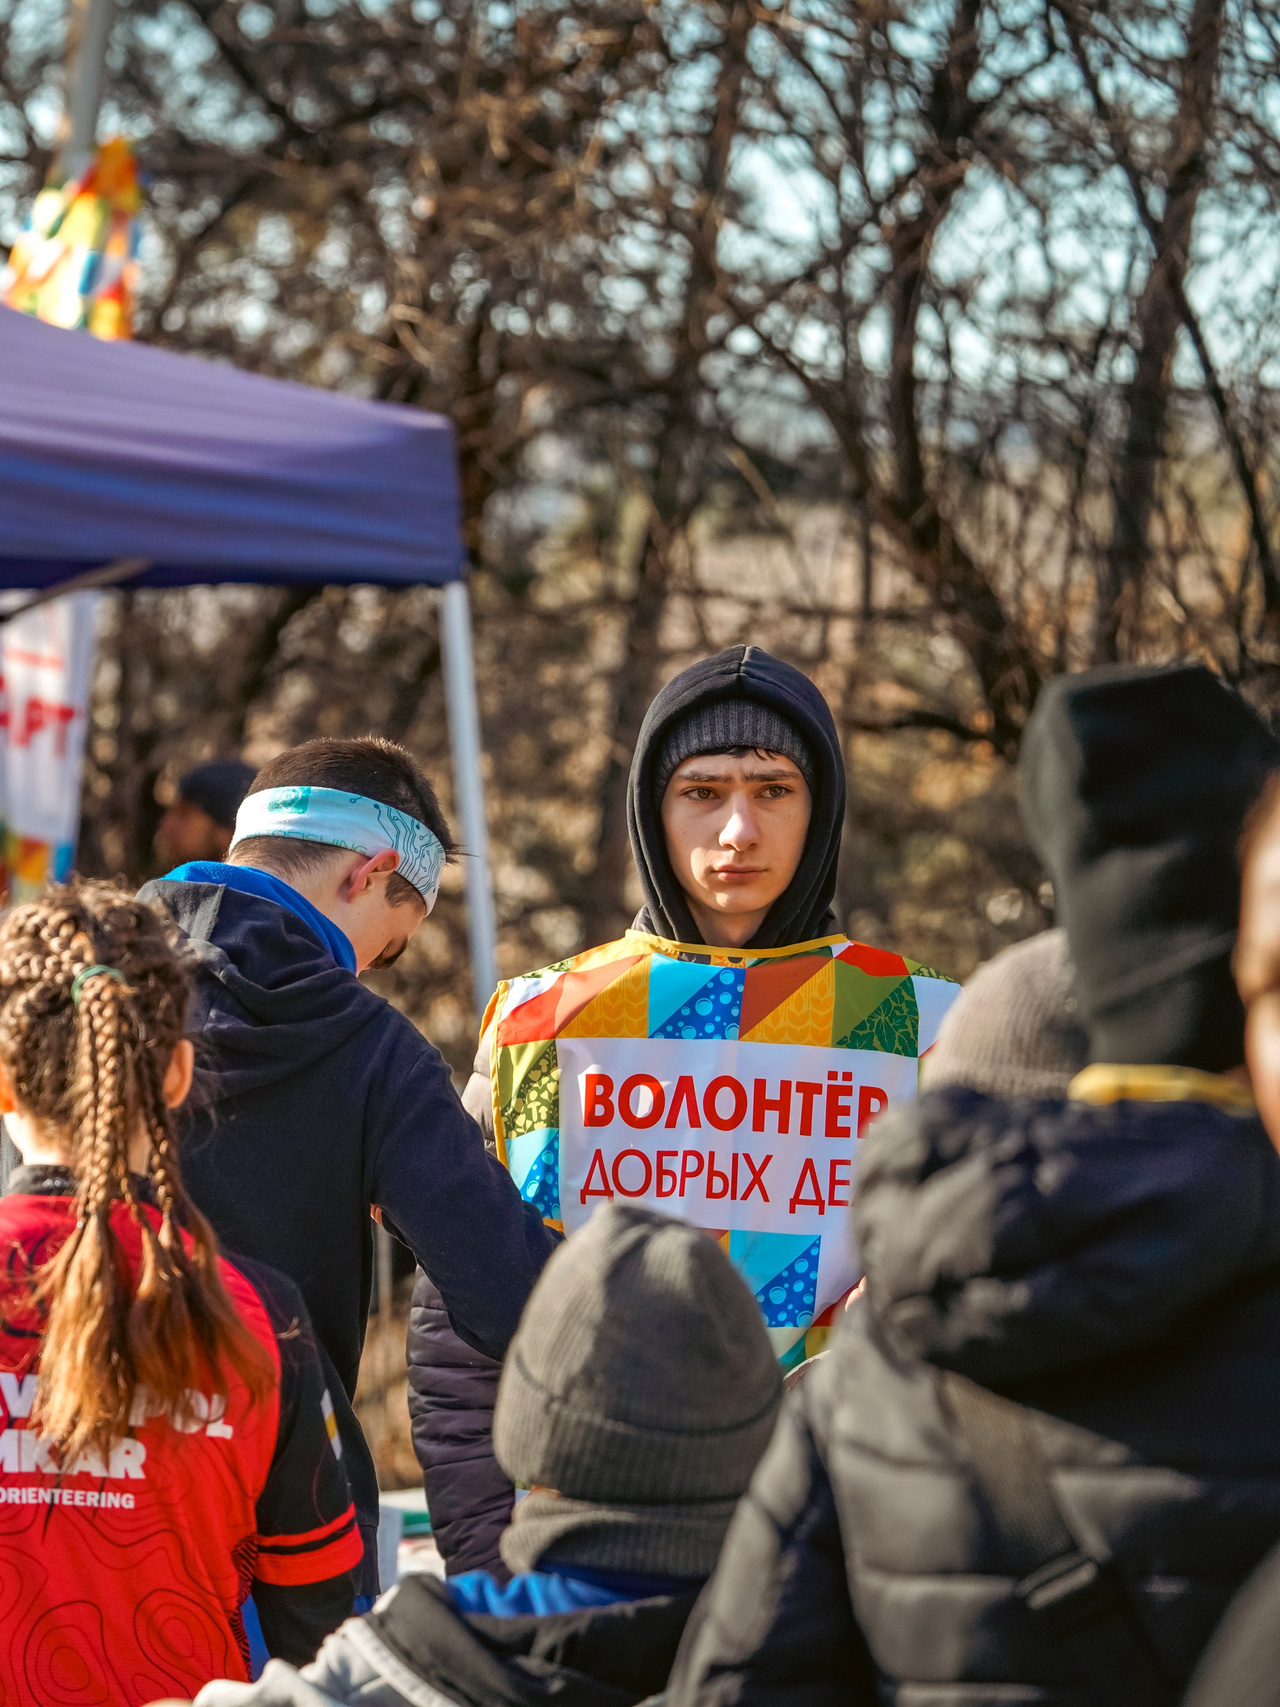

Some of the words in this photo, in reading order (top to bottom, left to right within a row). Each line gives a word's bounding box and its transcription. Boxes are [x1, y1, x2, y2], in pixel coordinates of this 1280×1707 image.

[583, 1070, 889, 1139] ВОЛОНТЁР
[580, 1148, 773, 1205] ДОБРЫХ
[788, 1157, 852, 1215] ДЕ
